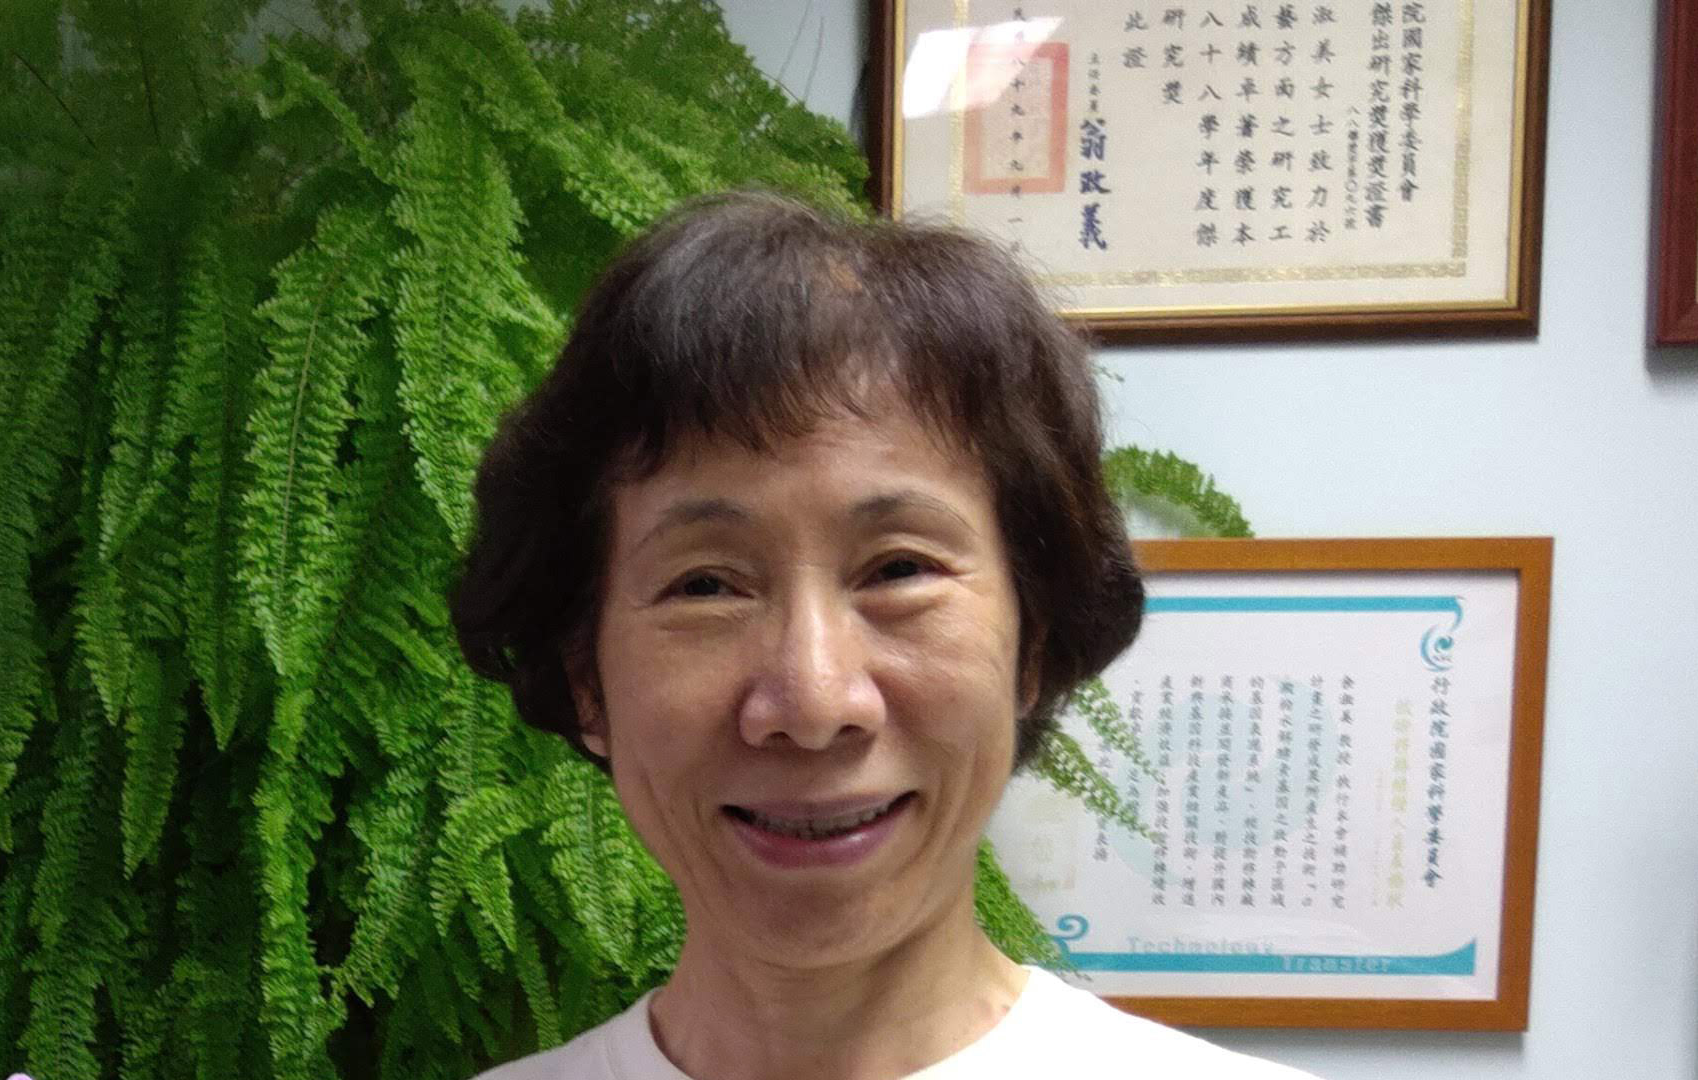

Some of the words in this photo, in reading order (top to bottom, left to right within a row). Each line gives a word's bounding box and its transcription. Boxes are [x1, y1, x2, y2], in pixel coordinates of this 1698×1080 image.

[1193, 9, 1224, 248] 八十八學年度傑
[1268, 3, 1299, 243] 藝方面之研究工
[1399, 1, 1427, 203] 院國家科學委員會
